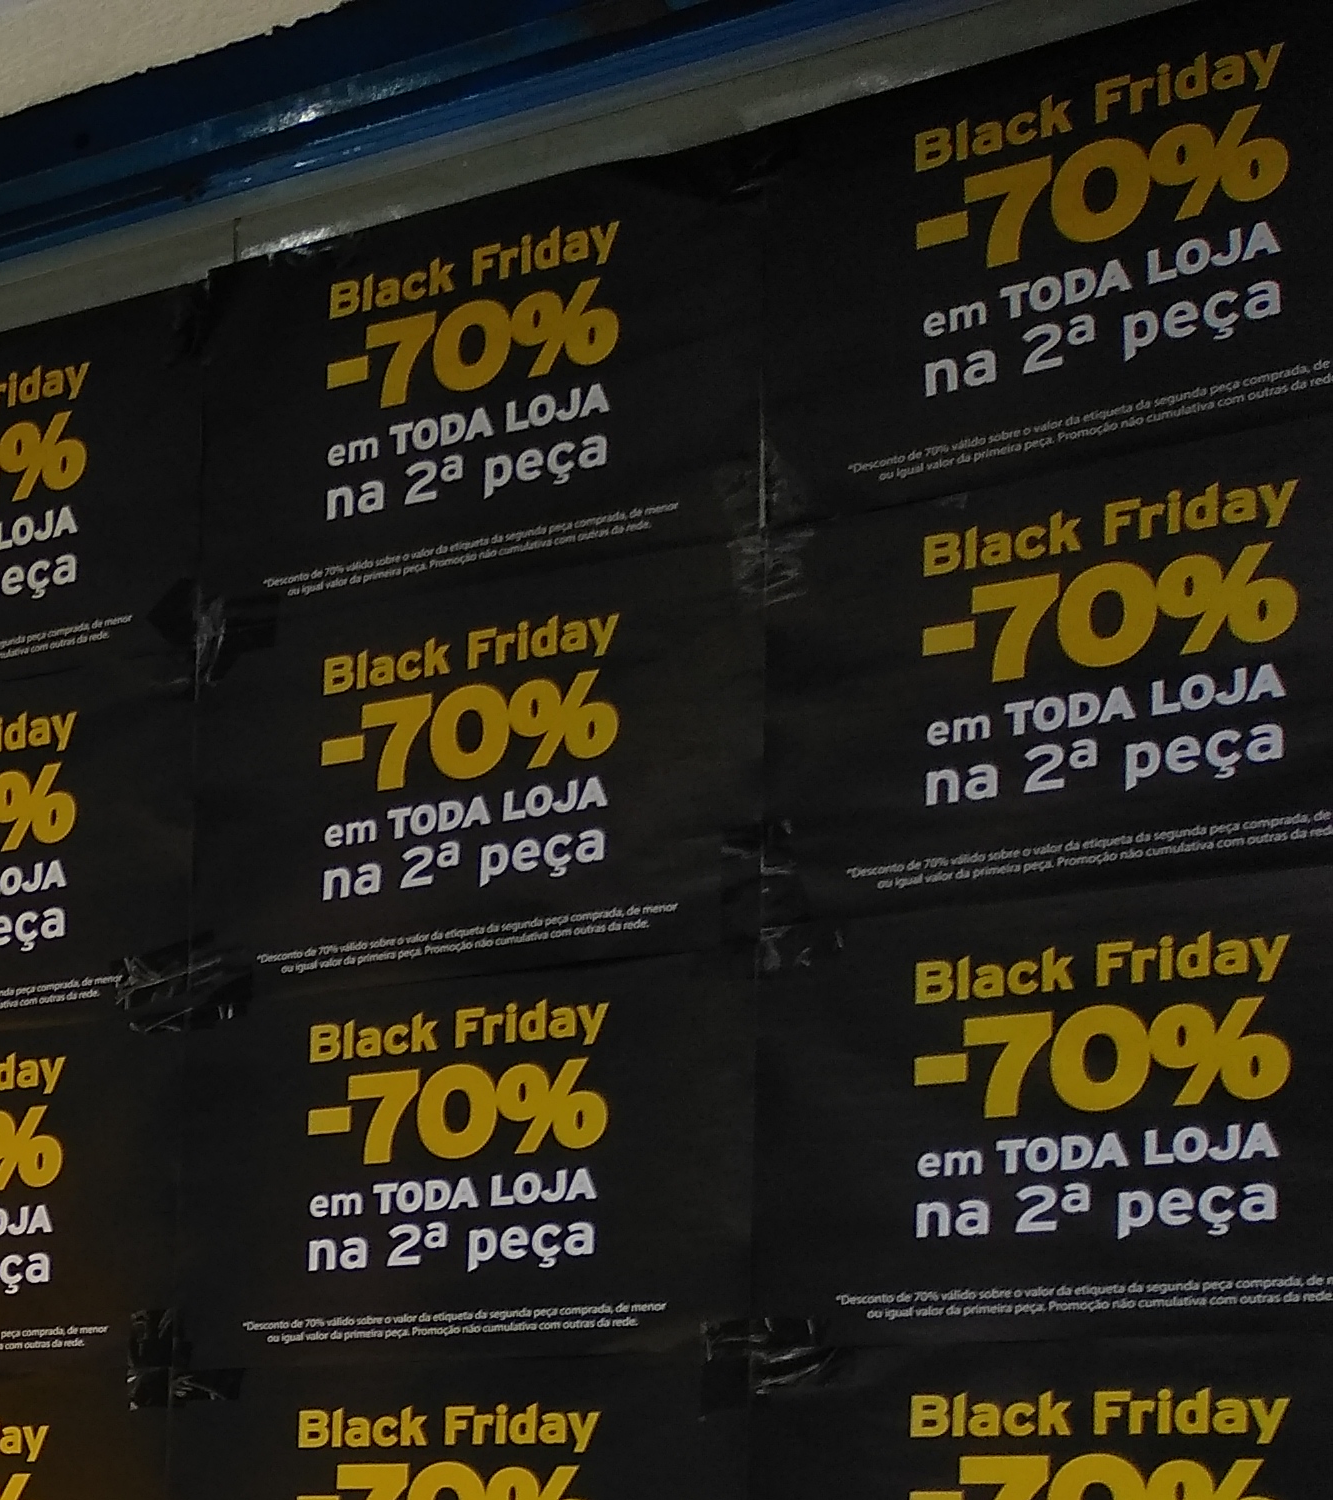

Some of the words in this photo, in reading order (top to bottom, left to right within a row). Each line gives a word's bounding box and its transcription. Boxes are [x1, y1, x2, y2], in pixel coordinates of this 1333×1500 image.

[914, 94, 1073, 173] Black
[1094, 41, 1285, 124] Friday
[916, 103, 1290, 268] -70%
[923, 301, 987, 337] em
[999, 258, 1133, 319] TODA
[1146, 221, 1282, 285] LOJA
[925, 349, 997, 398] na
[1122, 280, 1281, 362] peça
[323, 637, 451, 696] Black
[467, 613, 620, 670] Friday
[320, 668, 620, 792] -70%
[324, 819, 377, 848] em
[386, 795, 491, 840] TODA
[502, 776, 608, 822] LOJA
[322, 862, 382, 901] na
[479, 828, 605, 888] peça
[914, 946, 1074, 1005] Black
[1096, 930, 1291, 987] Friday
[913, 995, 1292, 1119] -70%
[917, 1149, 983, 1178] em
[995, 1132, 1130, 1174] TODA
[1144, 1122, 1280, 1166] LOJA
[915, 1199, 990, 1238] na
[1117, 1182, 1278, 1240] peça
[298, 1405, 428, 1449] Black
[444, 1402, 601, 1453] Friday
